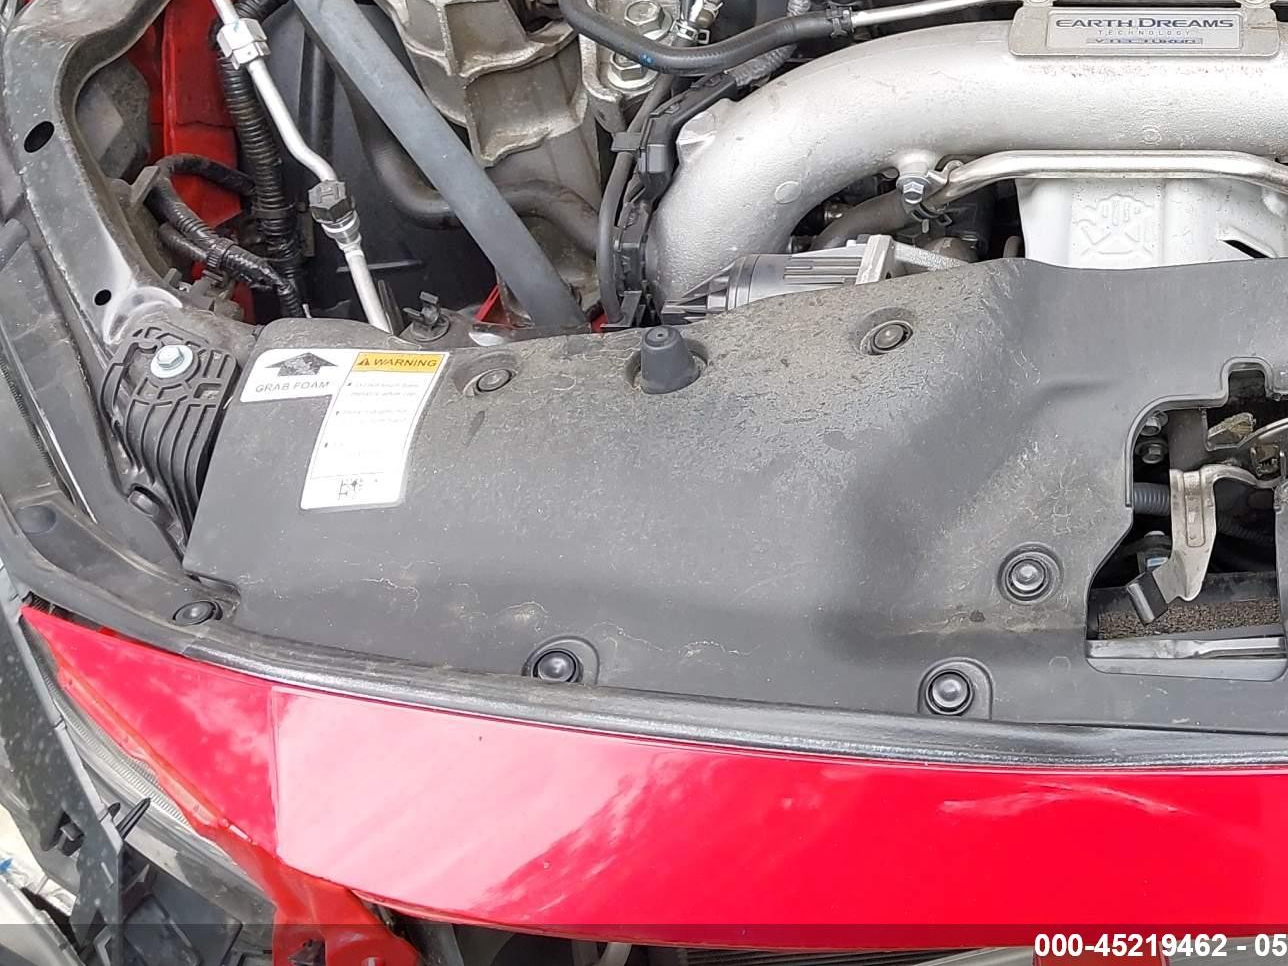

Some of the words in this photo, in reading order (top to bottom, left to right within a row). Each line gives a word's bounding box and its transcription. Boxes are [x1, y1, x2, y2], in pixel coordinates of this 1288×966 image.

[1055, 18, 1133, 28] EARTH
[1138, 17, 1234, 28] DREAMS
[373, 357, 438, 367] WARNING
[255, 383, 290, 393] GRAB
[292, 381, 330, 391] FOAM
